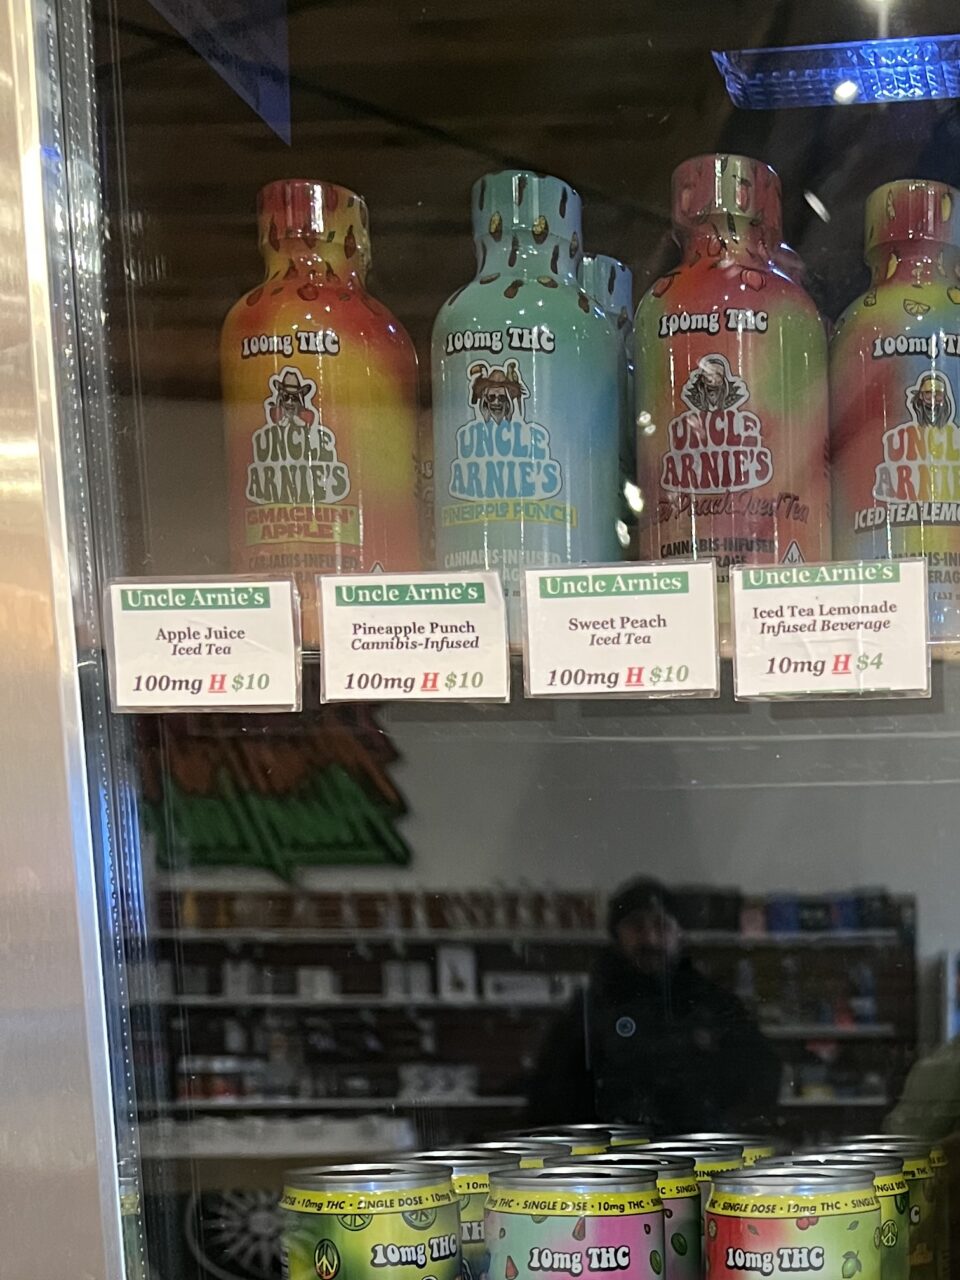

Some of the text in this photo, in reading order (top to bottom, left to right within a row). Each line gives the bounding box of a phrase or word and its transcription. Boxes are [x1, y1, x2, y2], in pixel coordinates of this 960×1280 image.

[660, 310, 768, 334] 100mg THC
[672, 412, 762, 450] UNCLE
[663, 449, 773, 490] ARNIE'S
[854, 506, 887, 530] ICED
[889, 502, 921, 522] TEA
[750, 560, 893, 585] Uncle Arnie's
[546, 575, 681, 594] Uncle Arnies
[127, 587, 265, 608] Uncle Arnie's
[753, 601, 896, 619] Iced Tea Lemonade
[352, 621, 475, 640] Pineapple Punch
[569, 614, 666, 630] Sweet Peach
[760, 620, 890, 636] Infused Beverage
[156, 626, 245, 644] Apple Juice
[351, 631, 479, 652] Cannibis-Infused
[590, 633, 651, 646] Iced Tea
[172, 643, 231, 655] Iced Tea
[767, 653, 883, 676] 10mg H $4
[134, 674, 269, 694] 100mg H $10
[727, 1247, 824, 1271] 10mg THC
